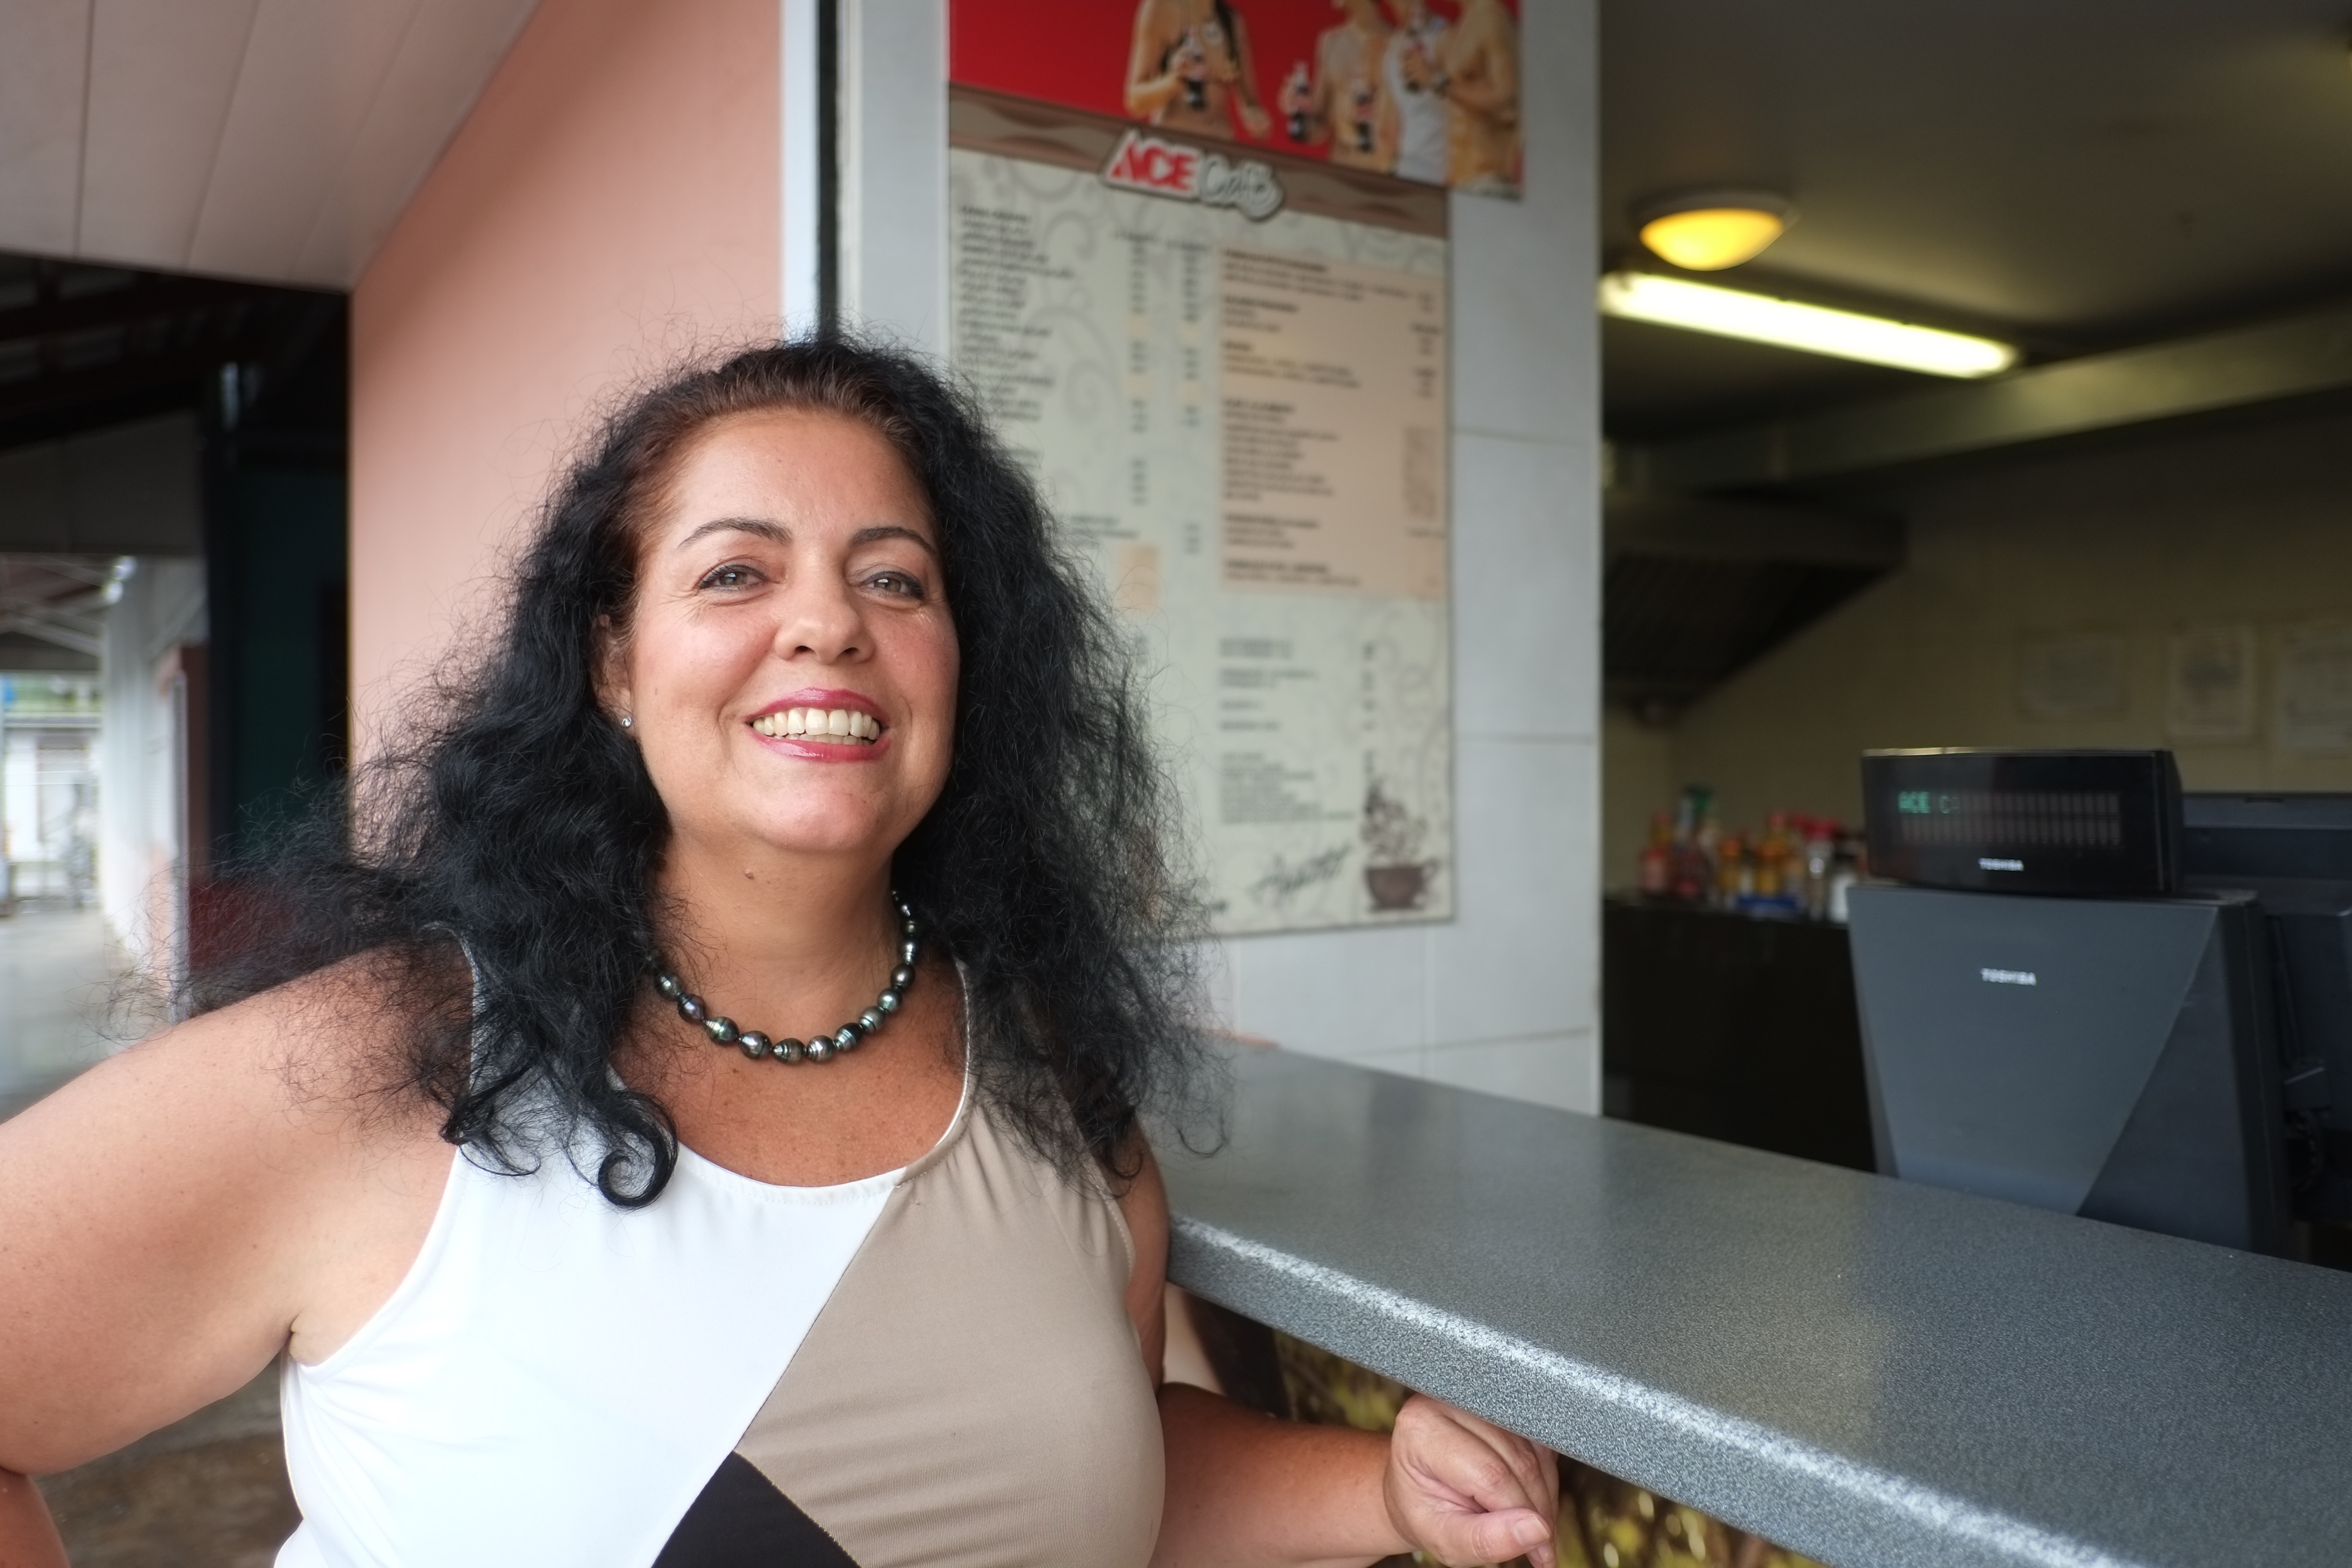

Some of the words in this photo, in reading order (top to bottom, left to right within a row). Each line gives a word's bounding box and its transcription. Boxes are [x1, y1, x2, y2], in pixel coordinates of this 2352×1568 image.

[1109, 136, 1198, 193] ACE
[1898, 792, 1931, 814] ACE
[1979, 858, 2024, 871] TOSHIBA
[1980, 968, 2037, 986] TOSHIBA
